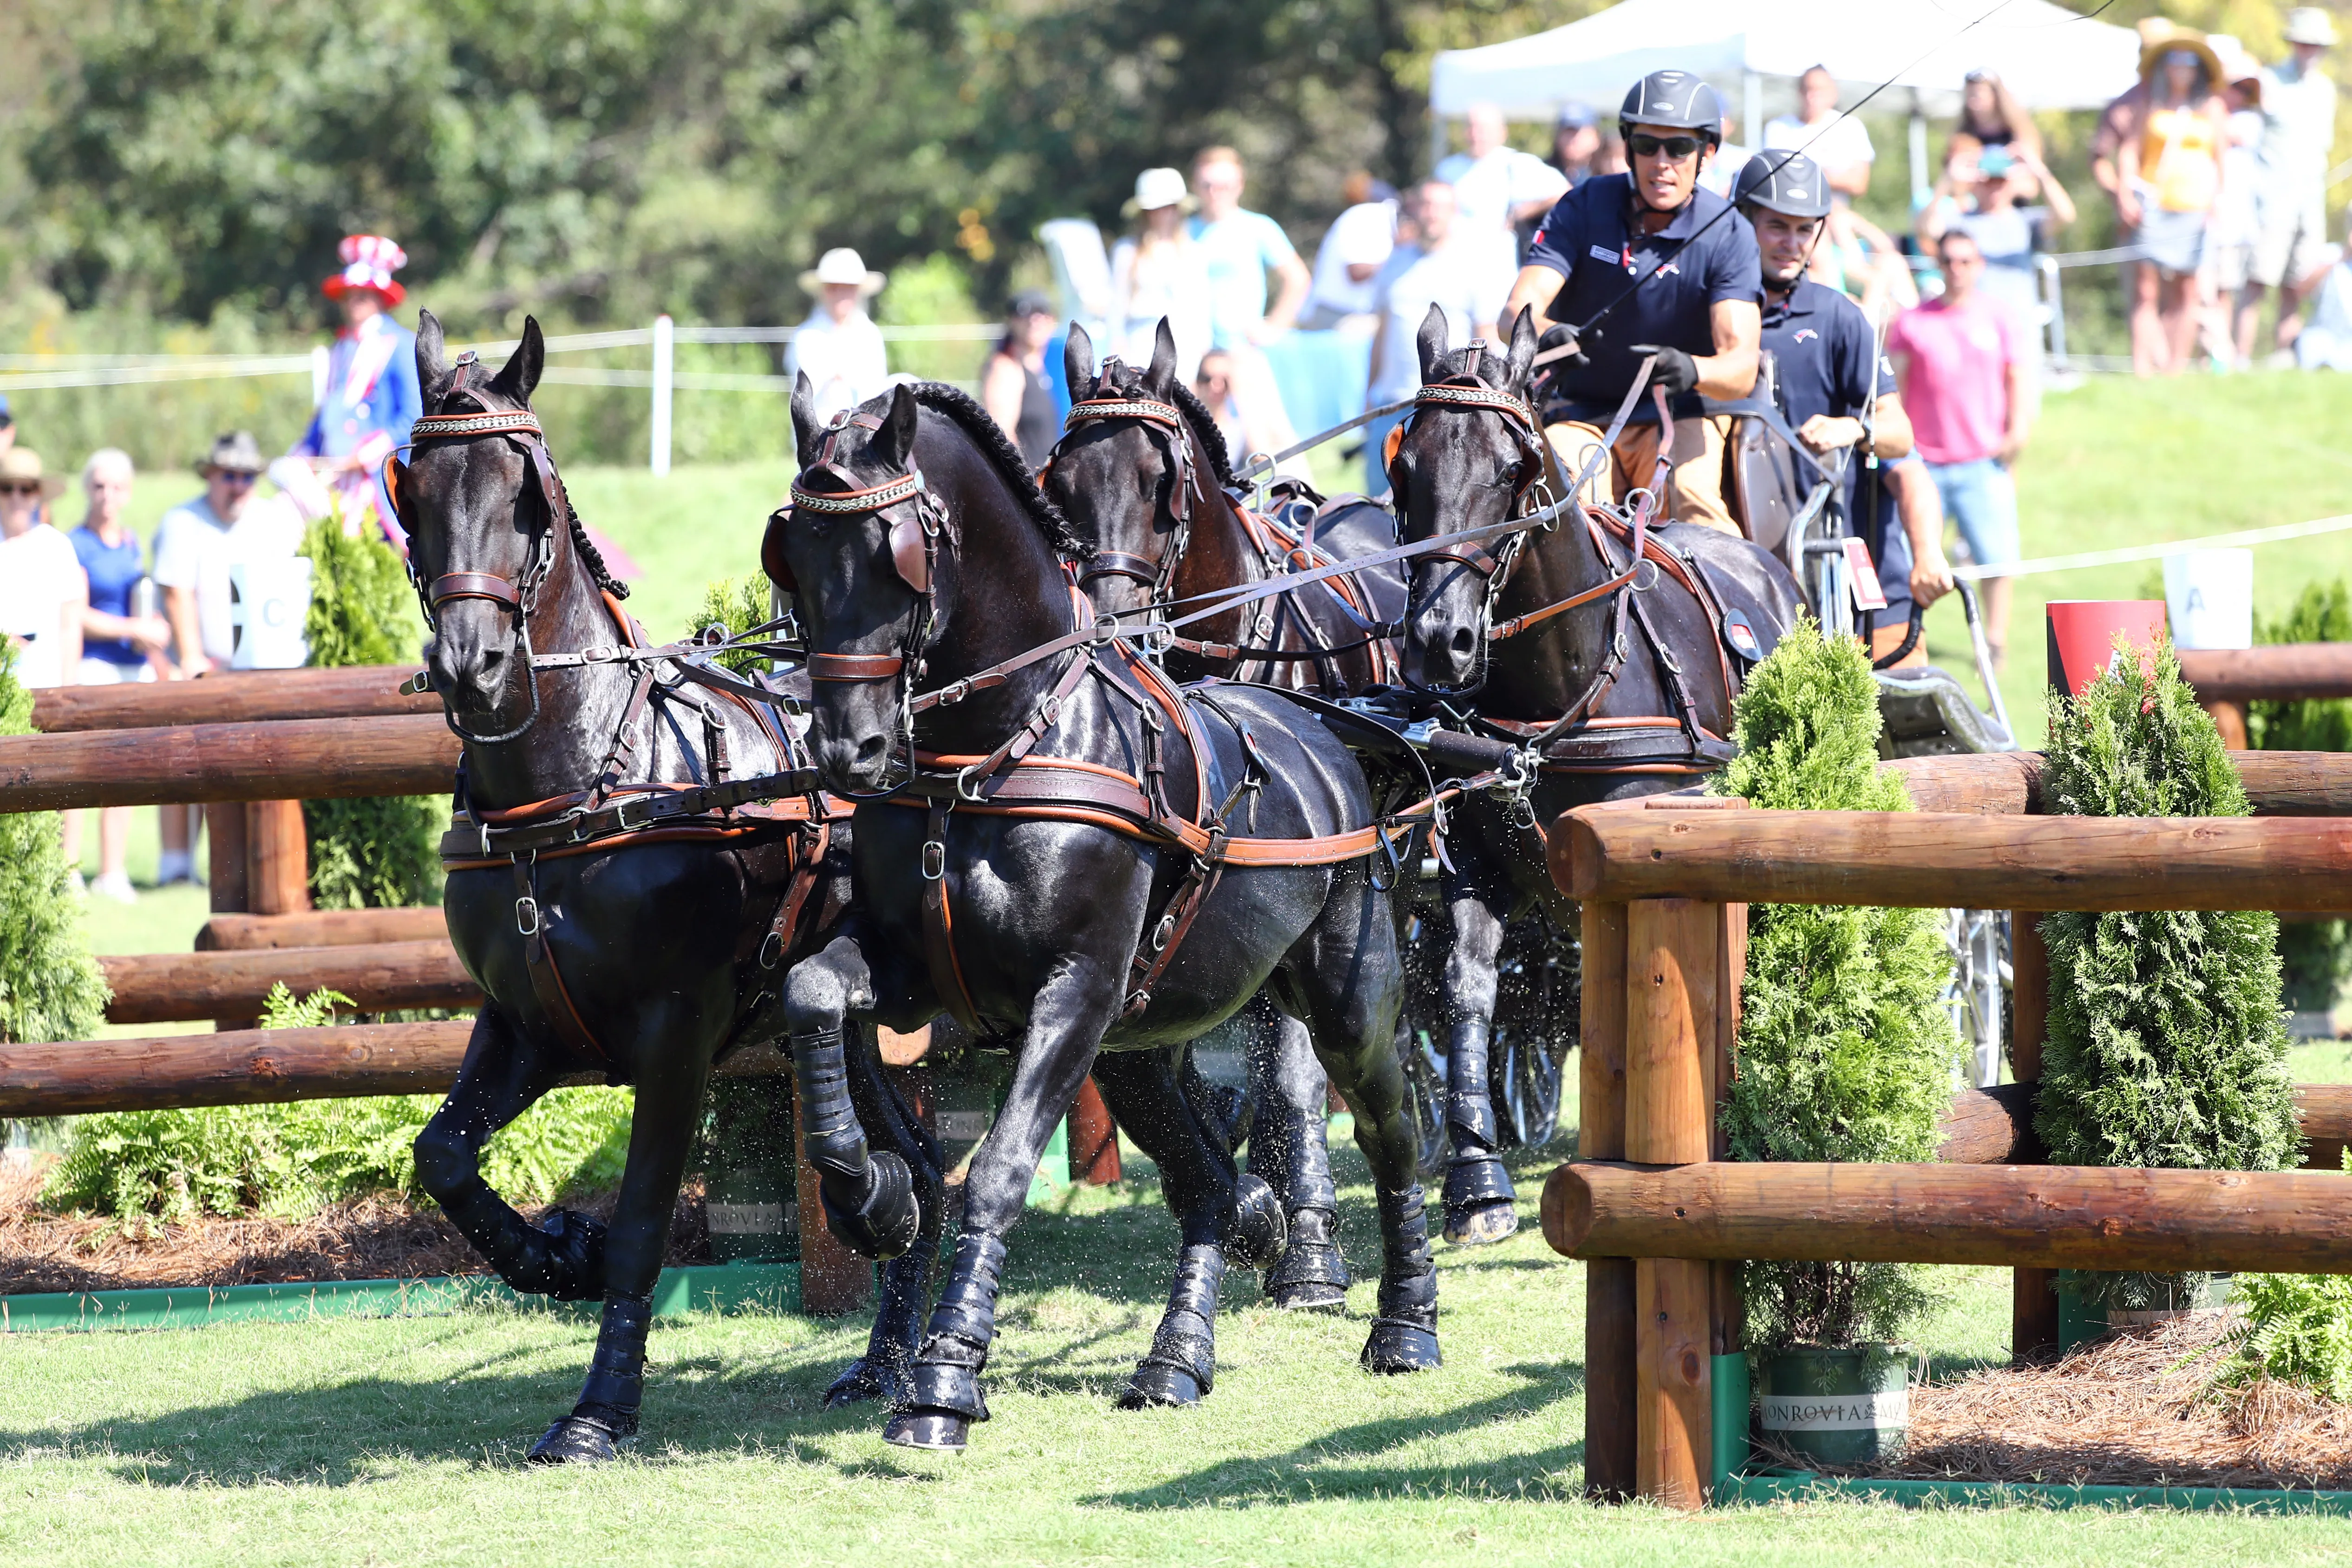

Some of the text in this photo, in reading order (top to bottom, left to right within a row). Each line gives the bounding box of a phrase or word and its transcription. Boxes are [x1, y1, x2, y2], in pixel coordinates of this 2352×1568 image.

[263, 598, 286, 627] C
[2186, 588, 2206, 614] A
[710, 1211, 777, 1226] NROVIA
